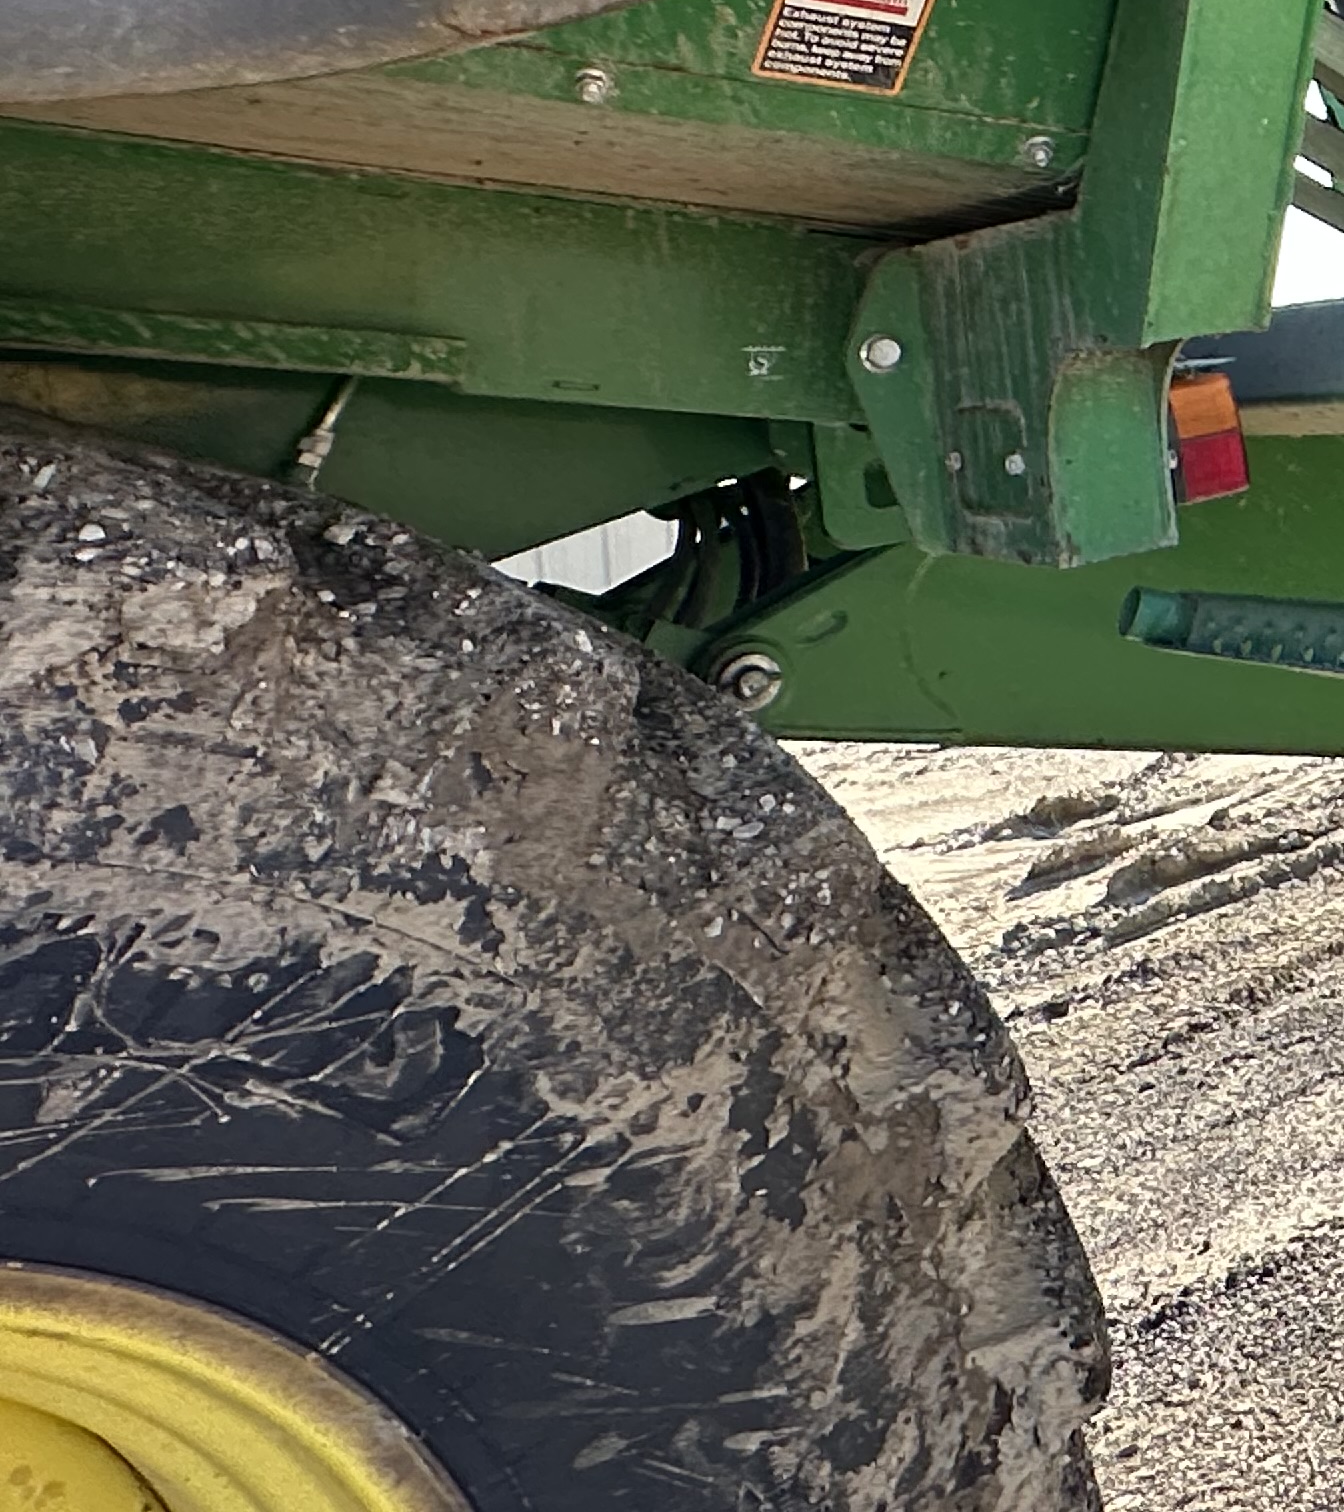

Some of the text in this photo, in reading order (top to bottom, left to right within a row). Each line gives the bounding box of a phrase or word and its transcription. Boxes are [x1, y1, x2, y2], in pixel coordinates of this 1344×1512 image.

[778, 19, 907, 46] components may be
[783, 6, 891, 34] Exhaust system
[804, 31, 820, 43] To
[821, 36, 859, 49] avoid
[860, 43, 904, 57] severe
[811, 44, 841, 58] keep
[842, 50, 874, 64] away
[875, 55, 902, 66] from
[767, 49, 874, 74] exhaust system
